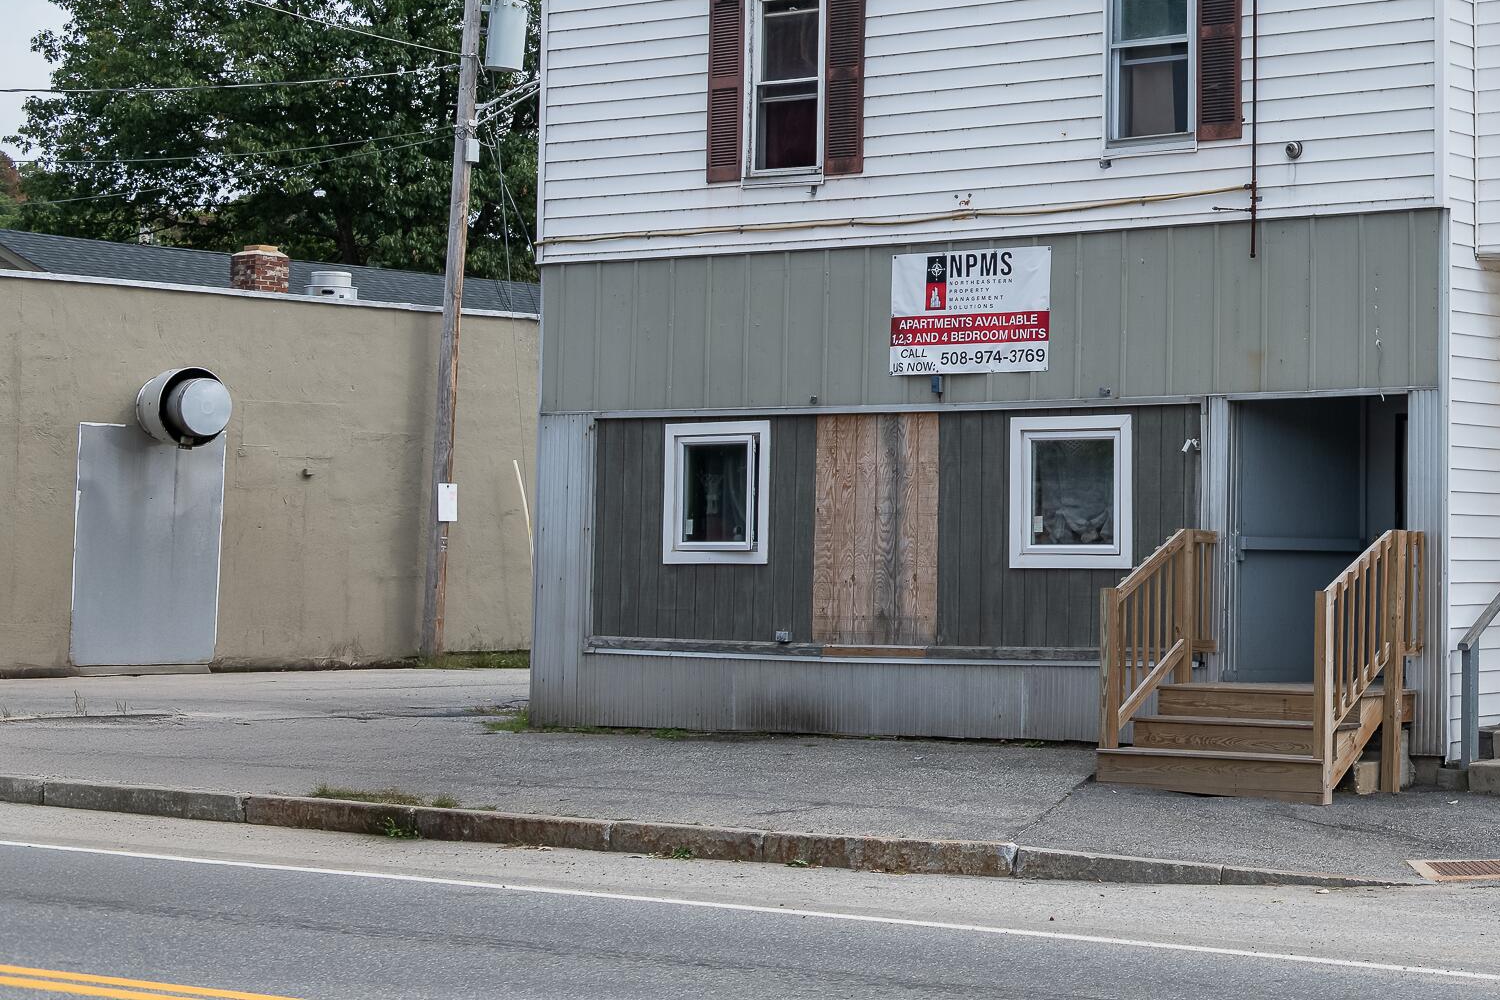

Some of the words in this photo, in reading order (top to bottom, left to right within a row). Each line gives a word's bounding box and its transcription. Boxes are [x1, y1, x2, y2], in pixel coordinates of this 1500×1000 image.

[950, 251, 1012, 278] NPMS
[899, 317, 973, 330] APARTMENTS
[974, 314, 1038, 327] AVAILABLE
[914, 332, 939, 343] AND
[941, 332, 948, 342] 4
[950, 330, 1008, 342] BEDROOM
[1010, 328, 1047, 340] UNITS
[900, 348, 928, 359] CALL
[940, 348, 1046, 366] 508-974-3769
[893, 362, 904, 373] US
[906, 361, 936, 372] NOW:
